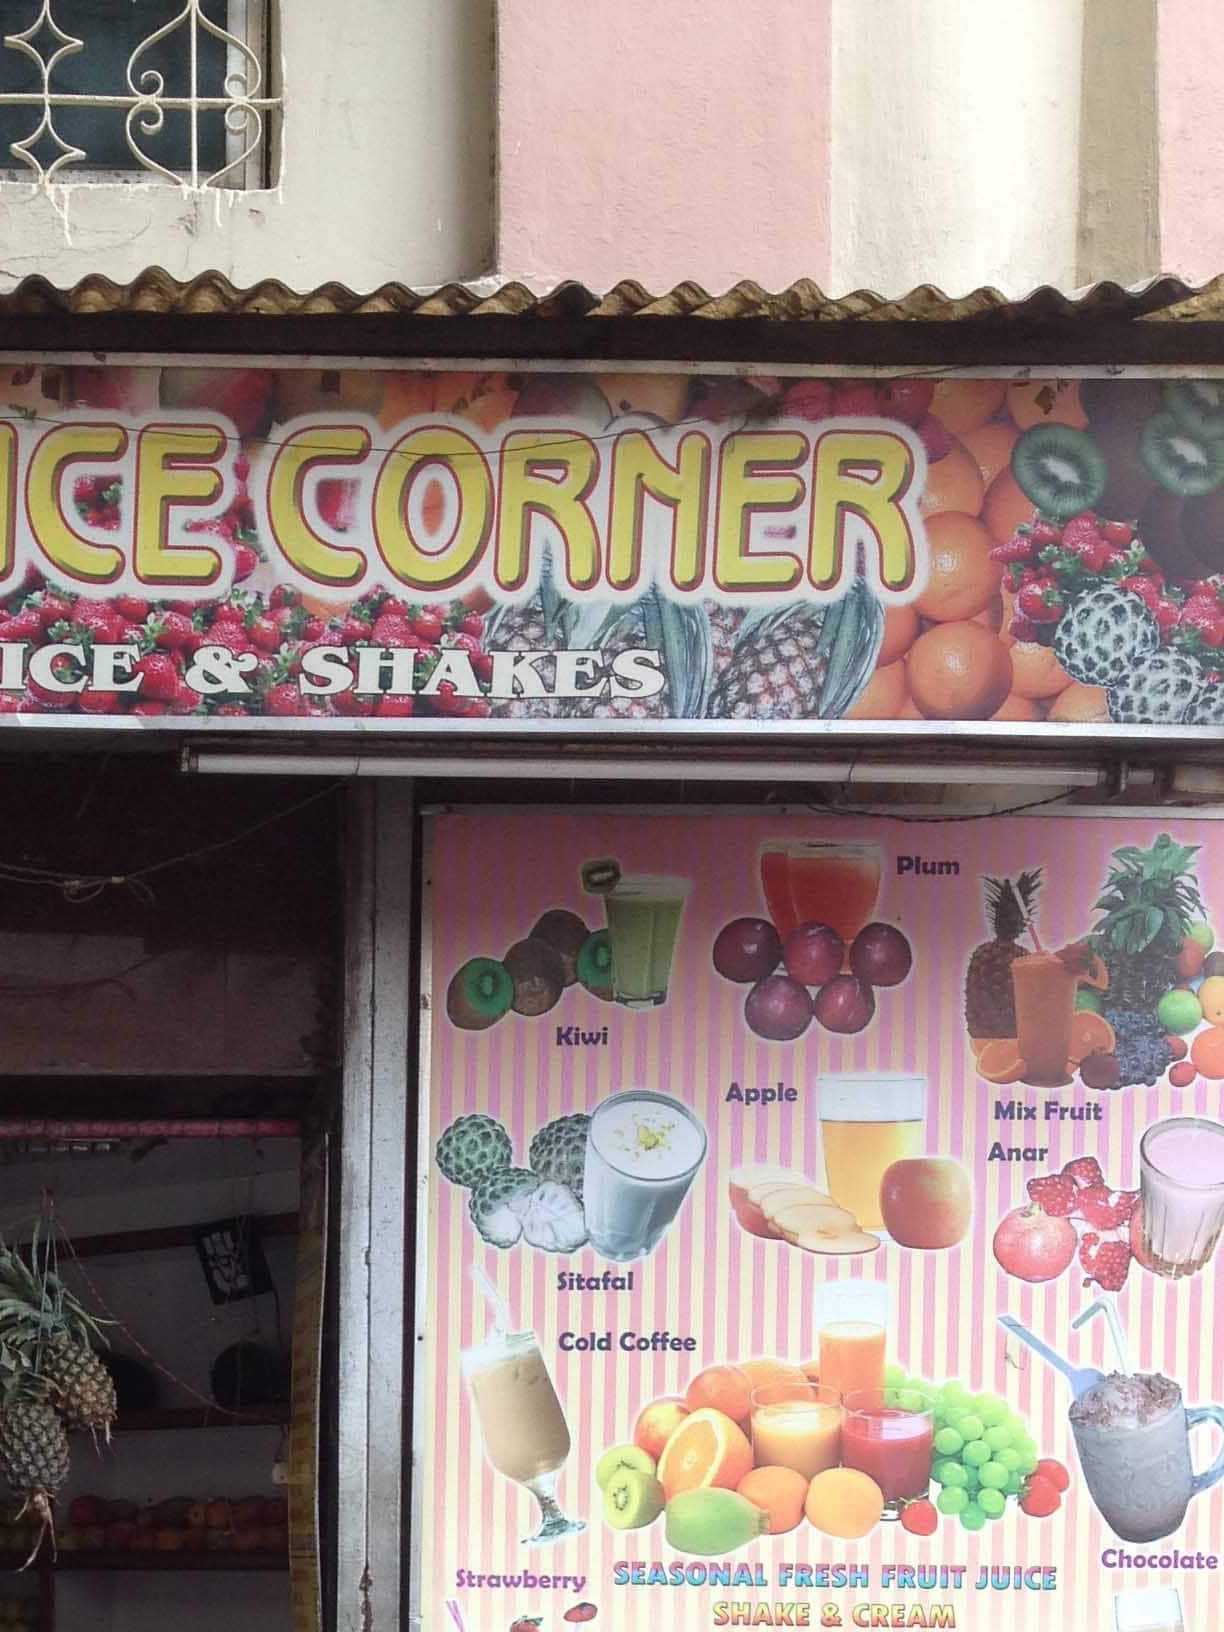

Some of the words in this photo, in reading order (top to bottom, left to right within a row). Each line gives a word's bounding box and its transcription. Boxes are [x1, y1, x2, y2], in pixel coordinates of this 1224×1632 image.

[266, 421, 921, 595] CORNER
[185, 643, 259, 694] &
[297, 645, 666, 699] SHAKES
[897, 856, 959, 875] Plum
[557, 1027, 608, 1045] Kiwi
[726, 1082, 797, 1106] Apple
[995, 1101, 1036, 1120] Mix
[1045, 1101, 1102, 1120] Fruit
[988, 1142, 1048, 1161] Anar
[558, 1271, 634, 1291] Sitafal
[558, 1332, 612, 1351] Cold
[620, 1331, 696, 1351] Coffee
[1102, 1549, 1218, 1569] Chocolate
[456, 1569, 586, 1593] Strawberry
[613, 1561, 768, 1586] SEASONAL
[779, 1563, 869, 1588] FRESH
[882, 1564, 966, 1589] FRUIT
[975, 1565, 1057, 1590] JUICE
[714, 1601, 810, 1626] SHAKE
[821, 1603, 842, 1627] &
[852, 1604, 956, 1628] CREAM
